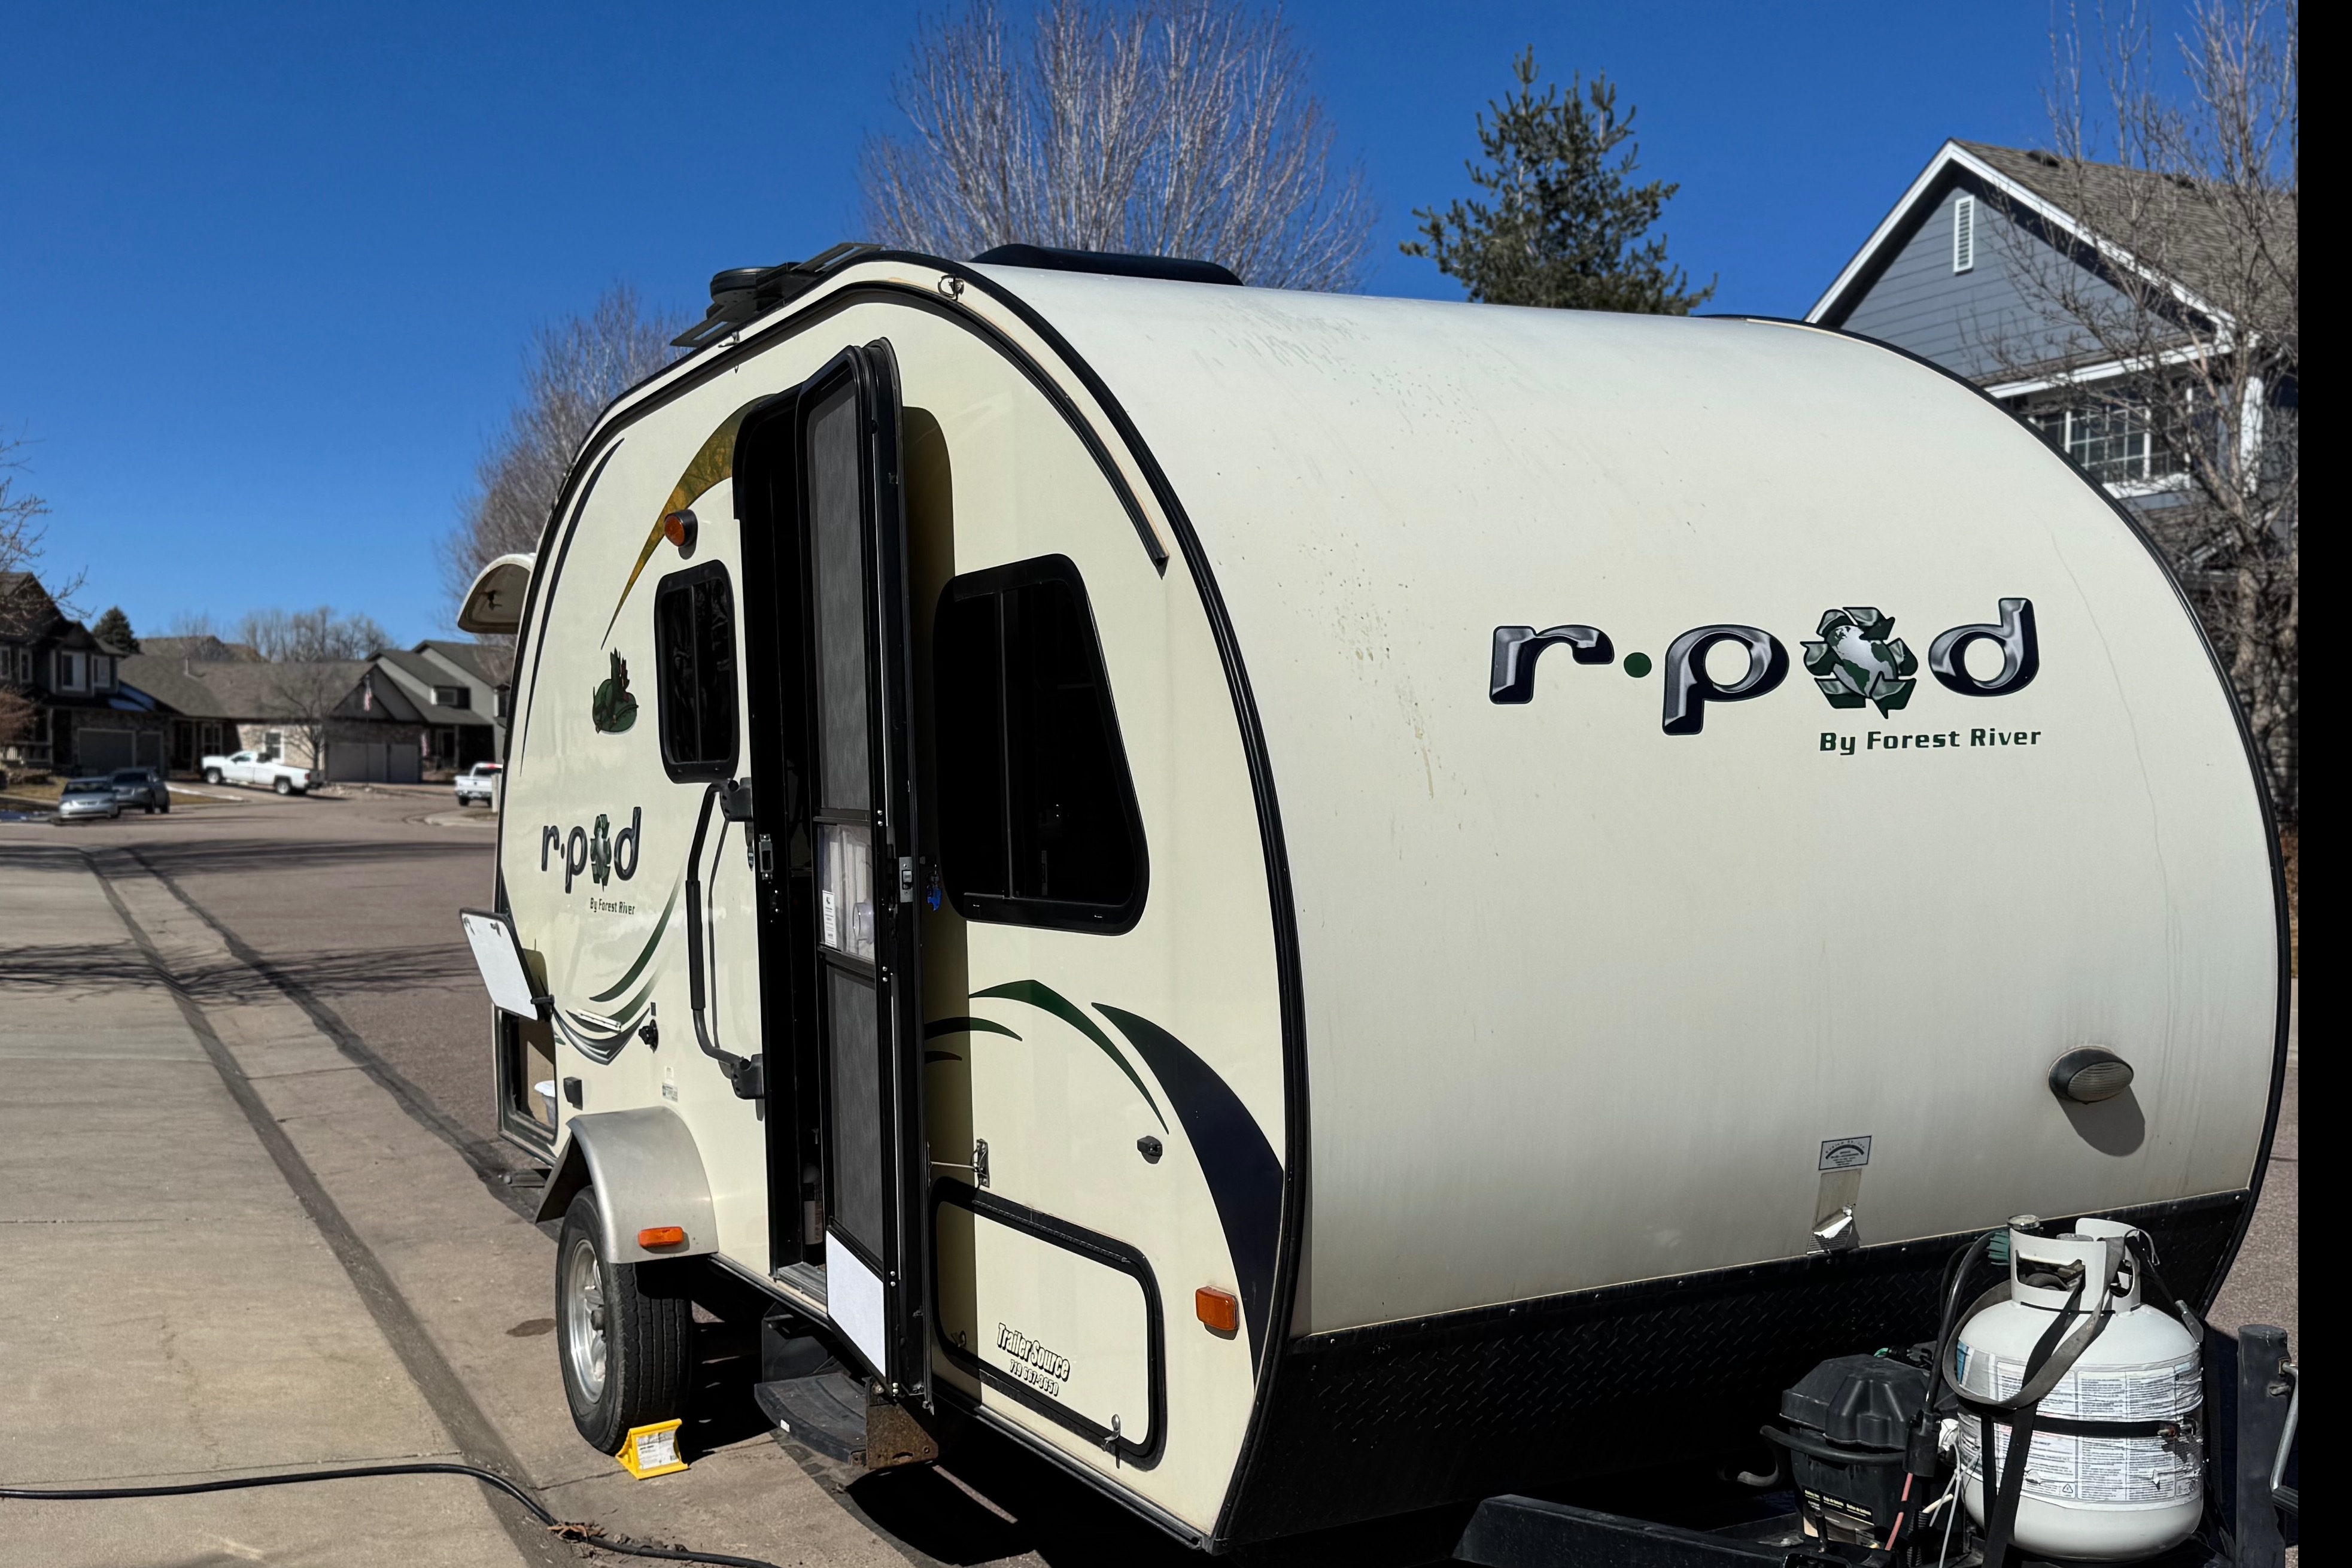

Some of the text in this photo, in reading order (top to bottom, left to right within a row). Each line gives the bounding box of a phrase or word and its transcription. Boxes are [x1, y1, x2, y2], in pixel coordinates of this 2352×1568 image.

[1819, 728, 2041, 755] By Forest River
[590, 897, 635, 915] By Forest River
